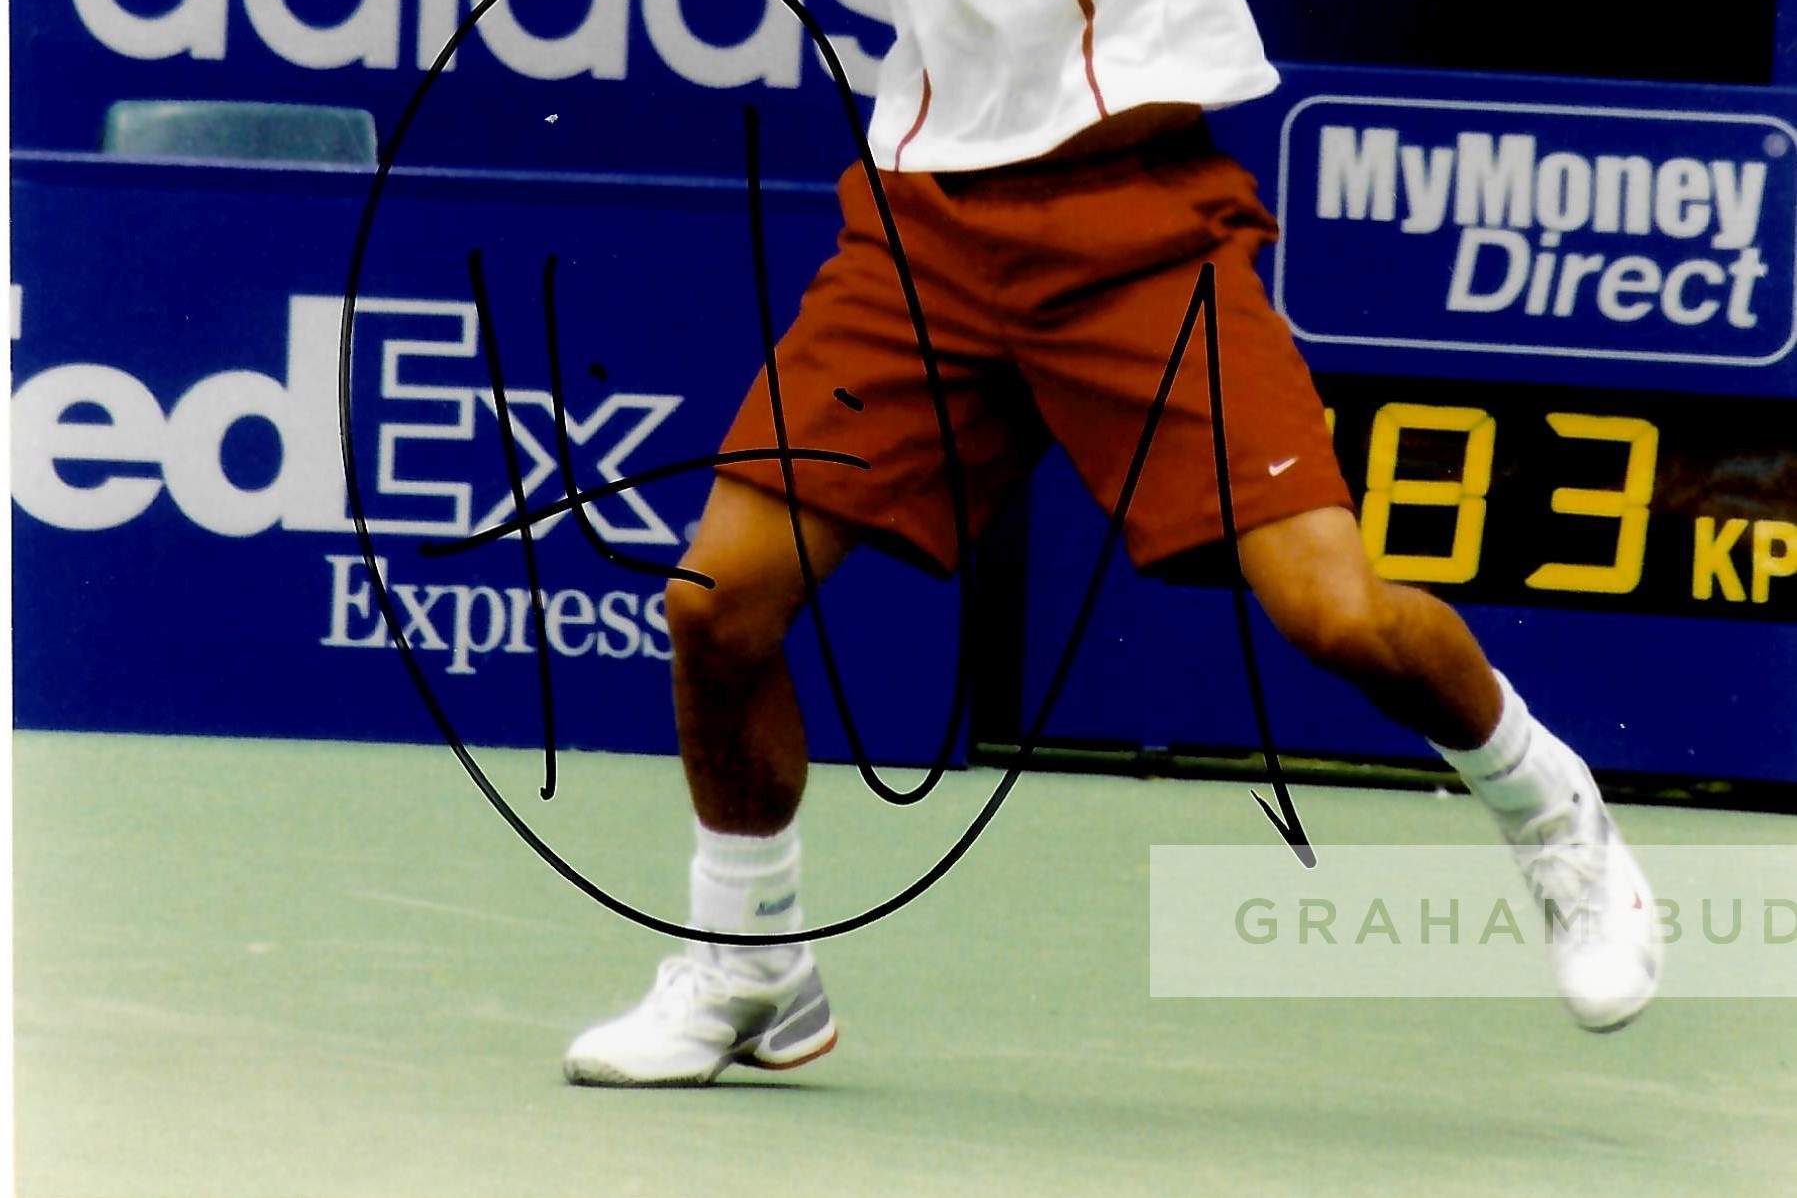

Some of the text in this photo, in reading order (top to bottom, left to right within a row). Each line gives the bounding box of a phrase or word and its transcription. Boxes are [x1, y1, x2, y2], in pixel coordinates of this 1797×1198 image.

[1316, 126, 1767, 250] MyMoney
[1446, 226, 1767, 329] Direct
[11, 284, 685, 545] edEx
[1324, 402, 1659, 594] 83
[320, 554, 677, 674] Express
